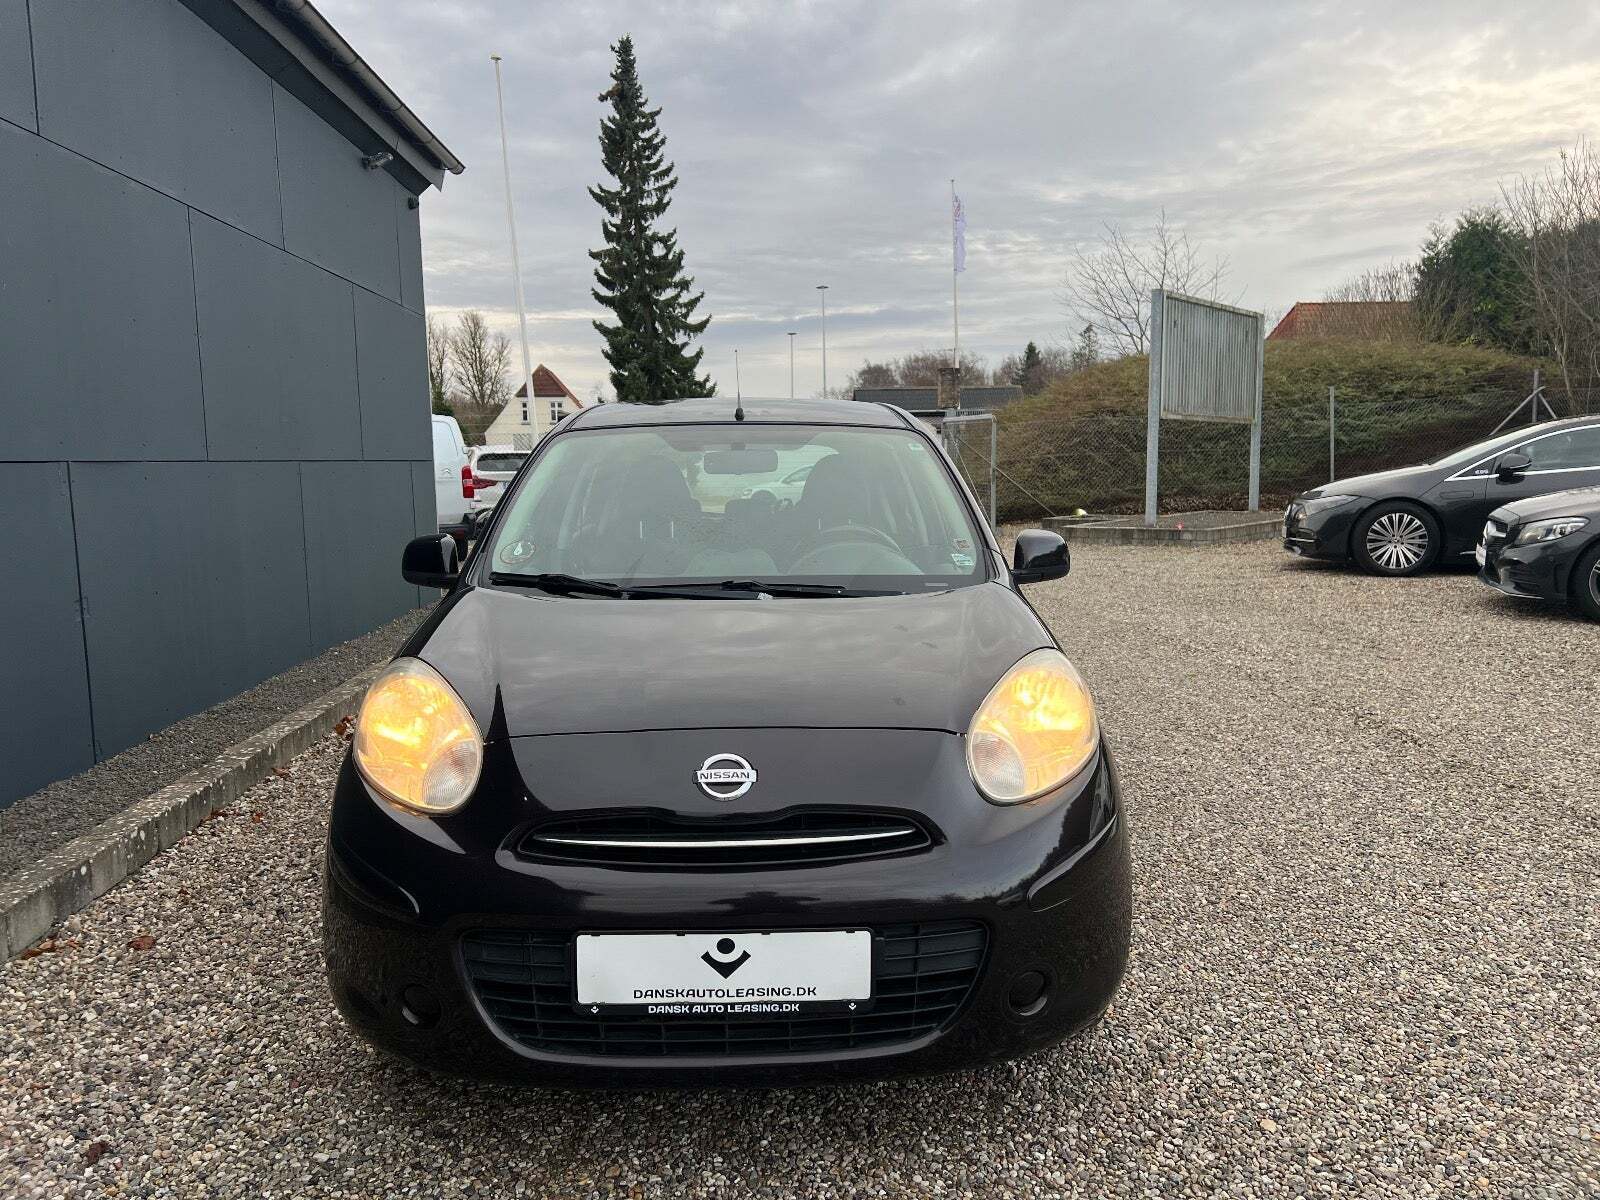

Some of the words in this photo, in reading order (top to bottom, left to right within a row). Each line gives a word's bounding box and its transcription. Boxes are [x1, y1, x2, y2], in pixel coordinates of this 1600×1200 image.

[700, 771, 750, 780] NISSAN
[633, 986, 817, 999] DANSKAUTOLEASING.DK
[648, 1004, 690, 1014] DANSK
[692, 1004, 724, 1013] AUTO
[727, 1003, 800, 1013] LEASING.DK
